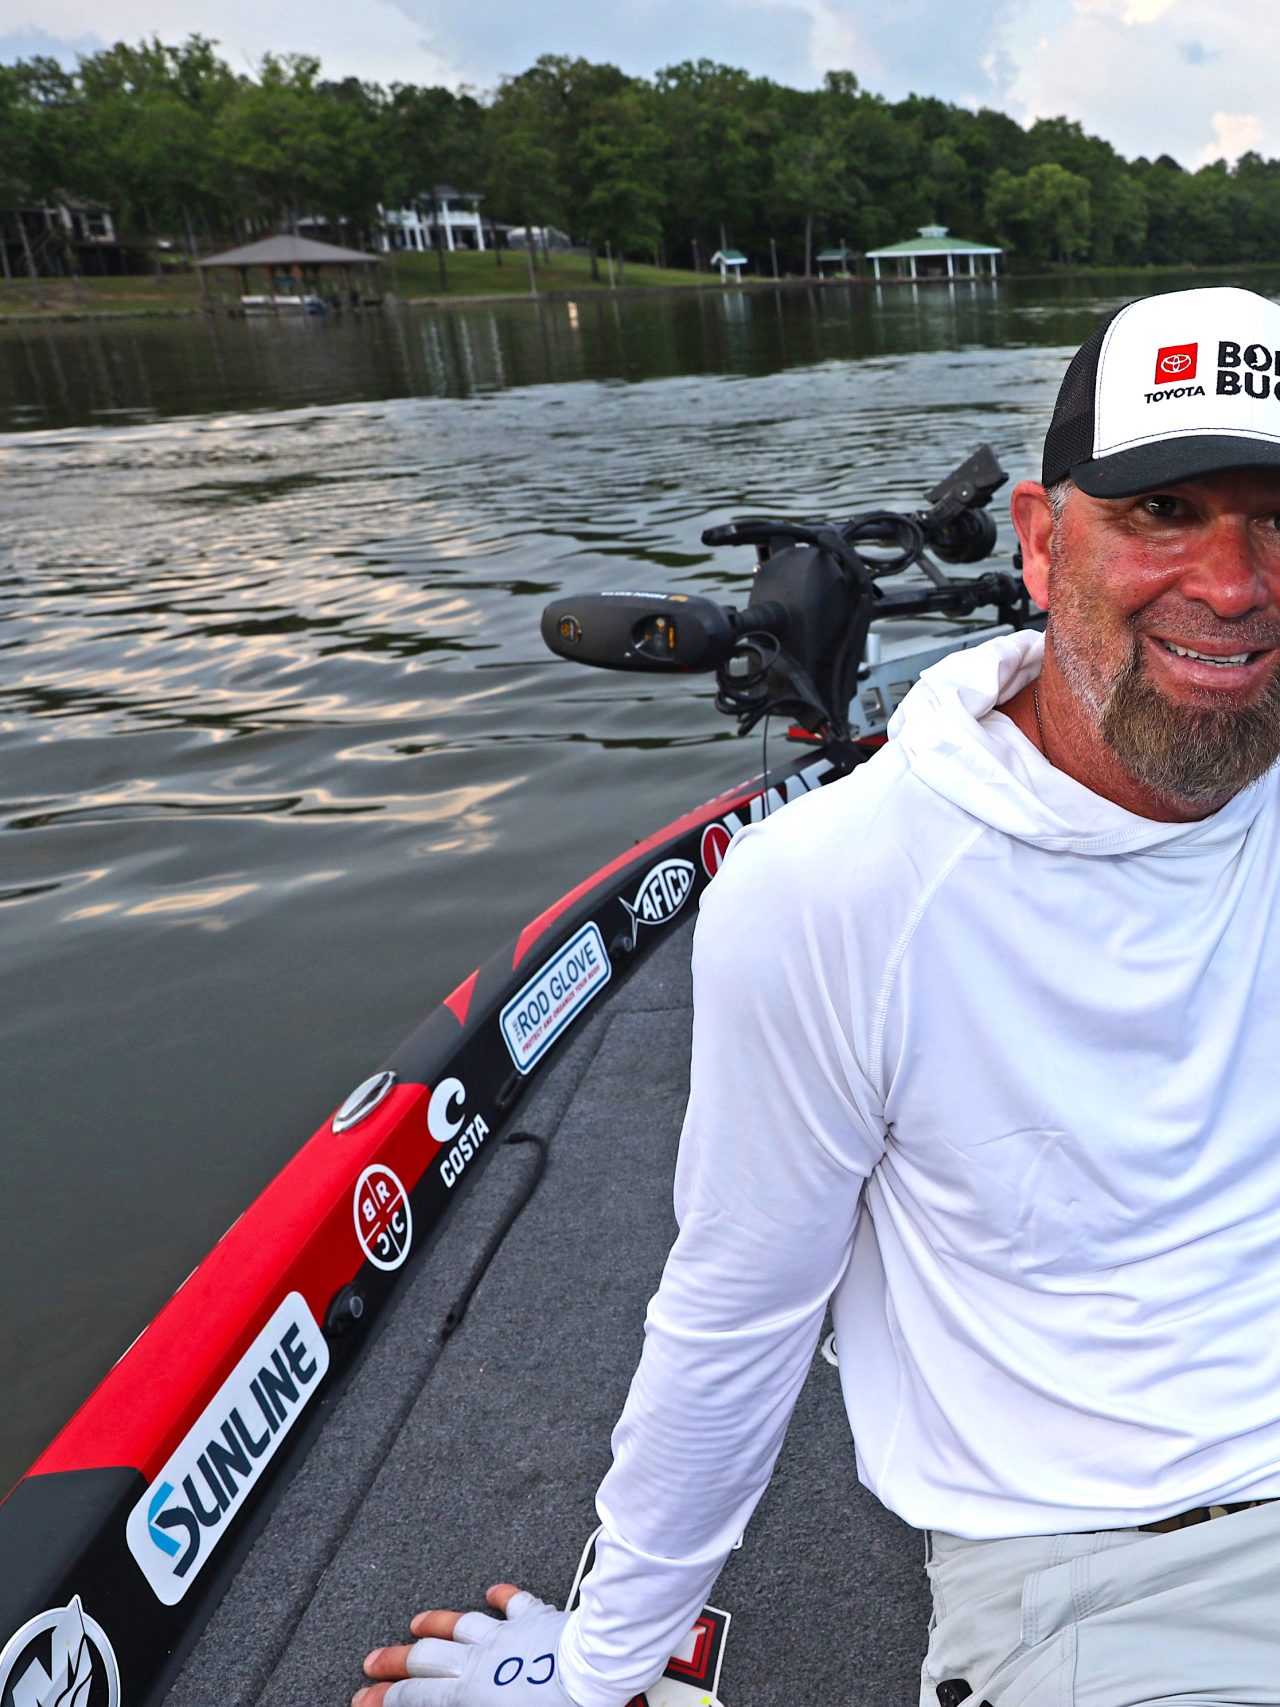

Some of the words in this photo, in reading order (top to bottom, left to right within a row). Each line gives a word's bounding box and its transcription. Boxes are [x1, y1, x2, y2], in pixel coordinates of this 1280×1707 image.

[1144, 385, 1205, 404] TOYOTA
[634, 858, 697, 920] AFTCO
[517, 991, 550, 1038] ROD
[550, 941, 598, 1000] GLOVE
[440, 1113, 490, 1188] COSTA
[147, 1322, 318, 1578] SUNLINE
